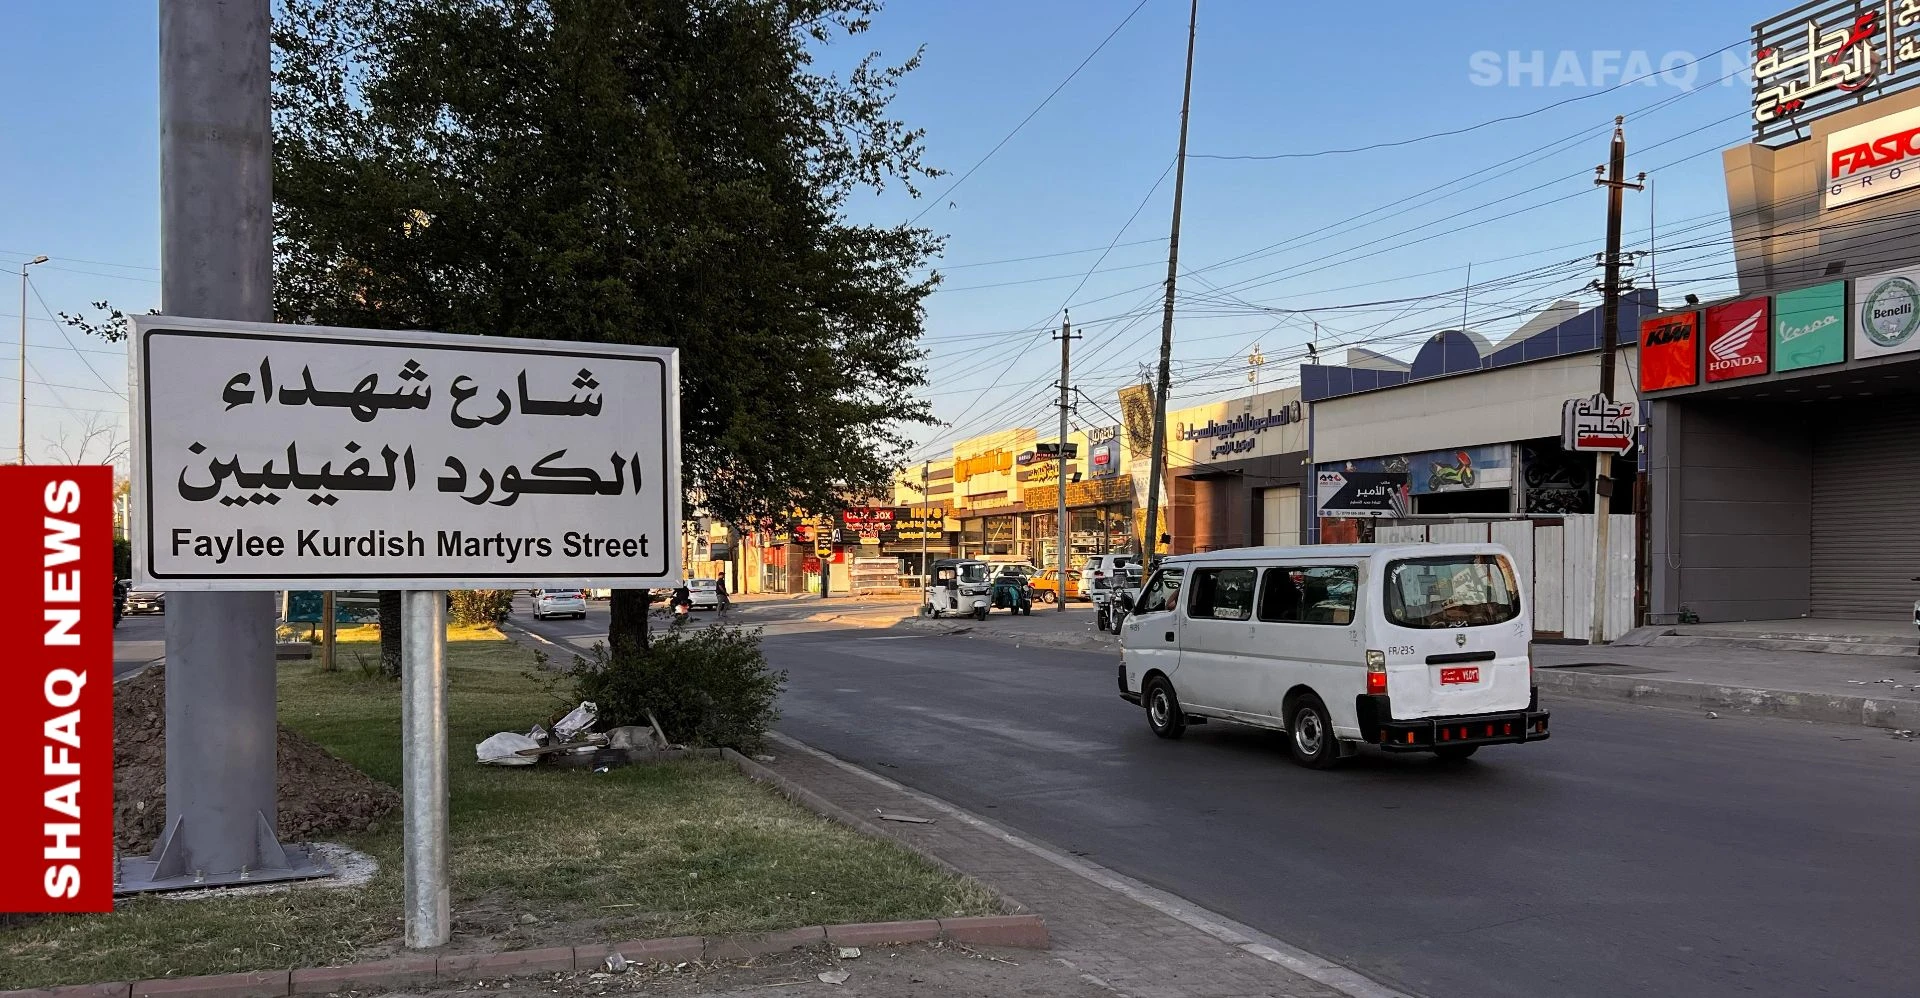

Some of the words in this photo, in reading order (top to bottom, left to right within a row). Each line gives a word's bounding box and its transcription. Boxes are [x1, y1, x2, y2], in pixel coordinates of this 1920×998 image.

[1831, 163, 1920, 196] GRO
[1873, 303, 1912, 319] Benelli
[1646, 322, 1692, 347] KTM
[1780, 314, 1839, 344] Vespa
[1709, 354, 1763, 371] HONDA
[222, 355, 432, 423] شهداء
[450, 368, 603, 428] شارع
[178, 440, 416, 507] الفيليين
[437, 448, 642, 507] الكورد
[1356, 486, 1385, 497] الأمير
[171, 528, 285, 564] Faylee
[297, 529, 425, 558] Kurdish
[437, 530, 552, 565] Martyrs
[563, 531, 649, 559] Street
